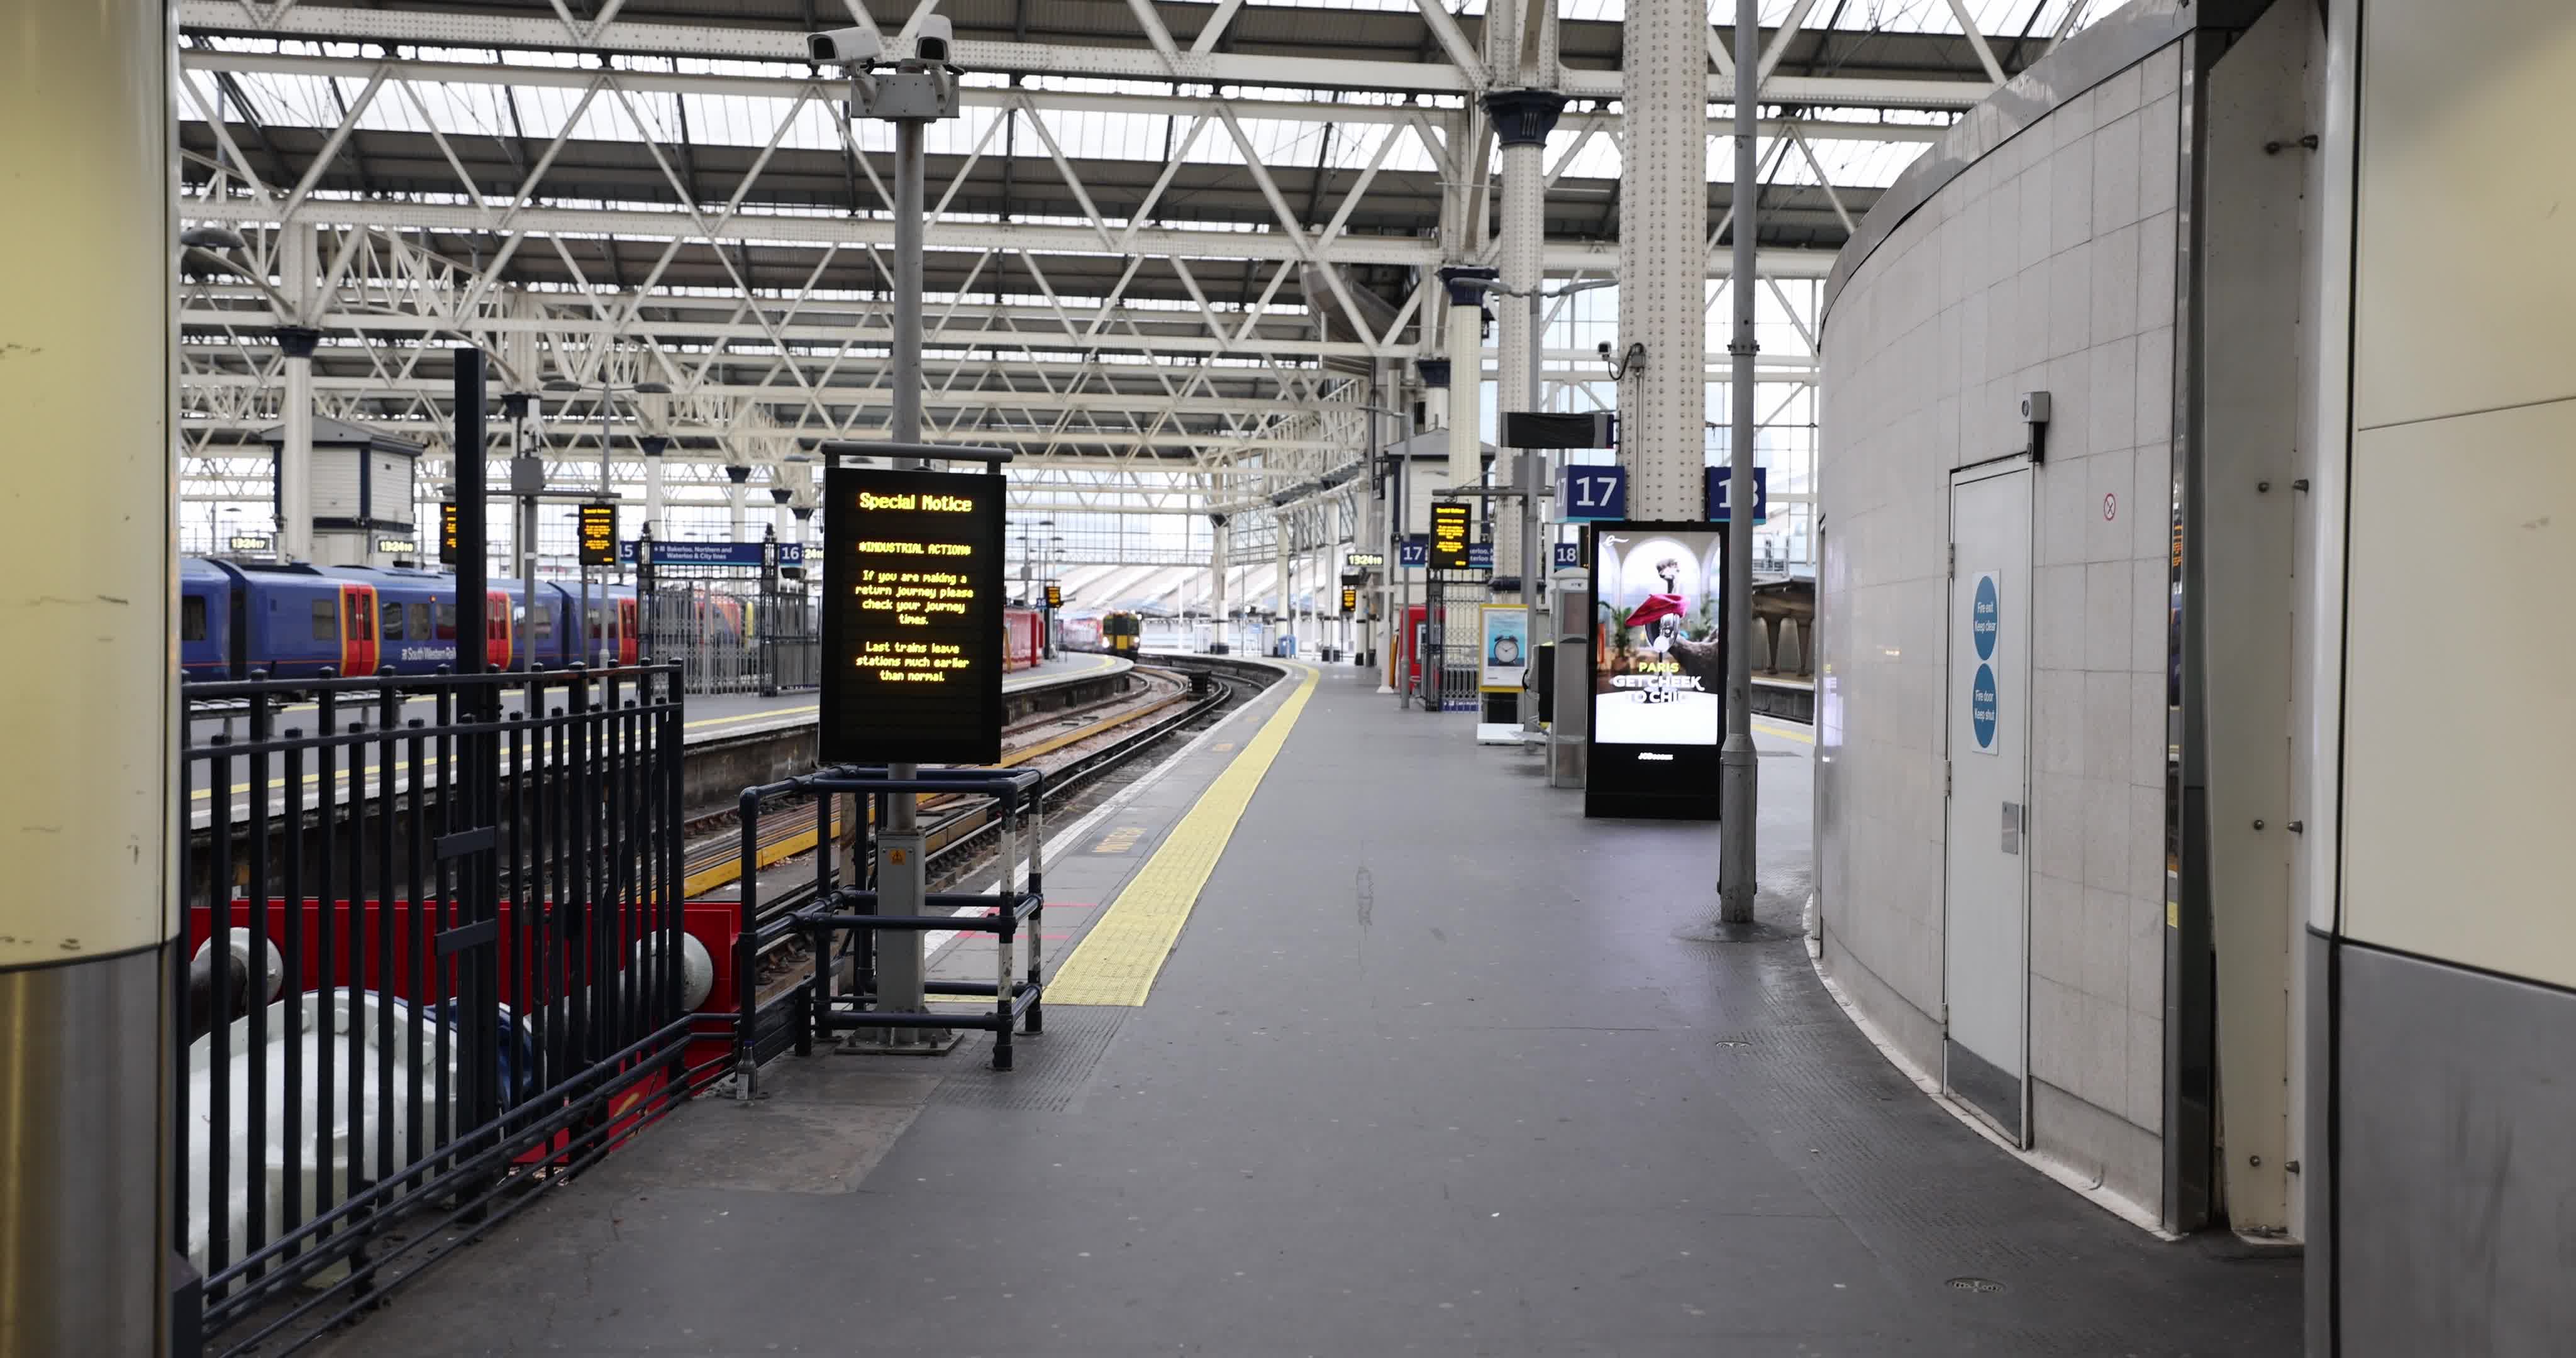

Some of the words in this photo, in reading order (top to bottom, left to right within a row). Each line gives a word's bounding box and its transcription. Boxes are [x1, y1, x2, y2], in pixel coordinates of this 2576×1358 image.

[1556, 478, 1567, 507] 17
[1576, 477, 1617, 506] 17
[860, 492, 915, 511] Special
[922, 495, 972, 512] Notice
[782, 547, 799, 560] 16
[1404, 546, 1422, 560] 17
[1557, 548, 1576, 561] 18
[863, 570, 875, 580] If
[878, 573, 897, 583] you
[901, 573, 919, 582] are
[923, 573, 957, 585] making
[960, 575, 967, 583] a
[855, 585, 892, 595] return
[896, 586, 936, 599] journey
[940, 587, 974, 599] please
[862, 599, 893, 610] check
[896, 602, 921, 612] your
[924, 602, 965, 614] journey
[1977, 602, 1985, 614] Fire
[899, 614, 929, 625] times.
[1975, 621, 1985, 634] Keep
[1985, 620, 1996, 631] clear
[445, 646, 457, 660] Rail
[866, 641, 891, 652] Last
[894, 642, 927, 653] trains
[931, 643, 960, 654] leave
[856, 655, 901, 666] stations
[904, 657, 930, 667] much
[933, 658, 970, 668] earlier
[1639, 662, 1680, 673] PARIS
[880, 670, 904, 681] than
[908, 671, 945, 682] normal.
[1613, 675, 1644, 688] GET
[1647, 676, 1705, 692] CHEEK
[1984, 690, 1993, 702] door
[1975, 708, 1985, 722] Keep
[1985, 709, 1994, 720] shut
